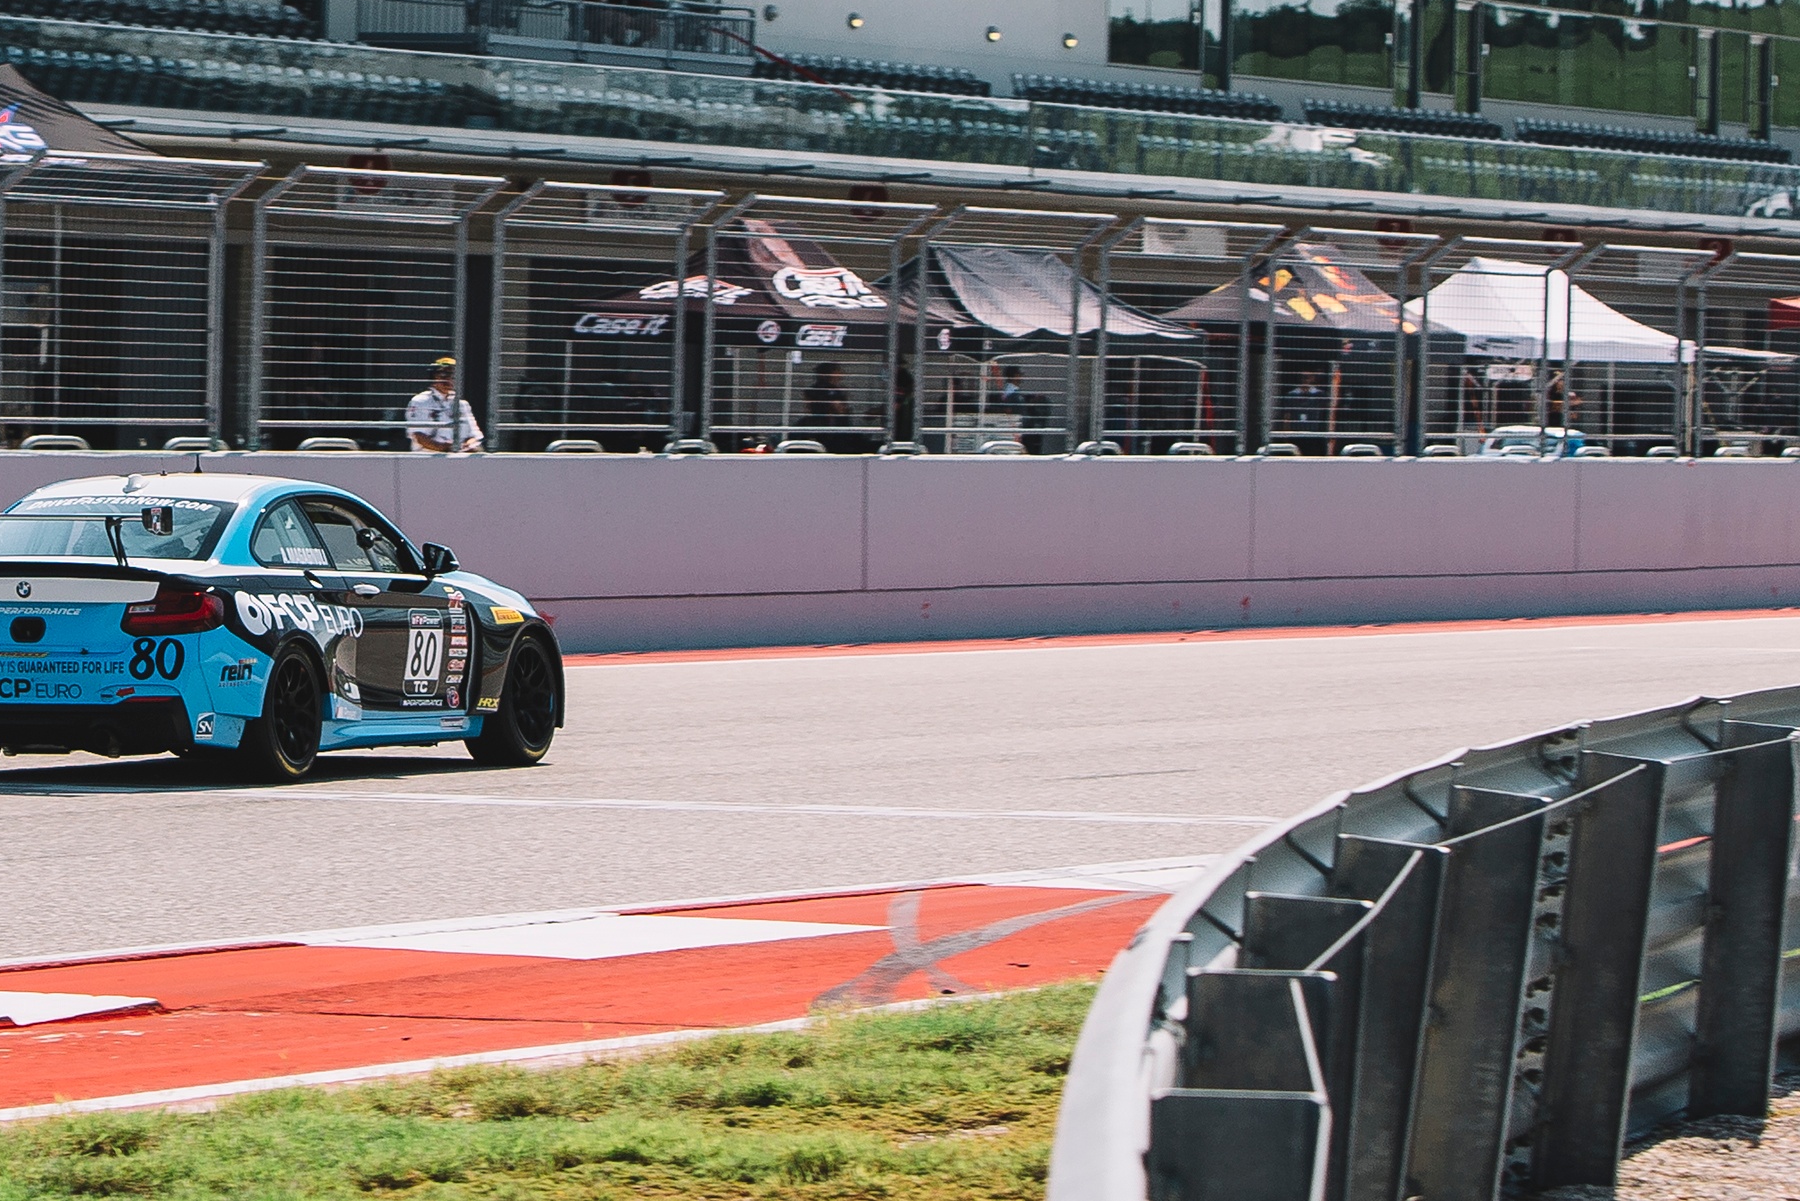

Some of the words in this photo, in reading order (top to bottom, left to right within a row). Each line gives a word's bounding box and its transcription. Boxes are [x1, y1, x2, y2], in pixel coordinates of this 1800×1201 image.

[257, 593, 320, 632] FCP
[316, 604, 365, 638] EURO
[128, 637, 185, 681] 80
[410, 630, 438, 677] 80
[7, 661, 16, 673] IS
[17, 661, 79, 673] GUARANTEED
[82, 661, 101, 674] FOR
[104, 661, 125, 674] LIFE
[220, 663, 254, 681] rein
[35, 684, 83, 699] EURO
[413, 680, 429, 694] TC
[478, 697, 500, 709] HRX
[198, 720, 214, 734] SN
